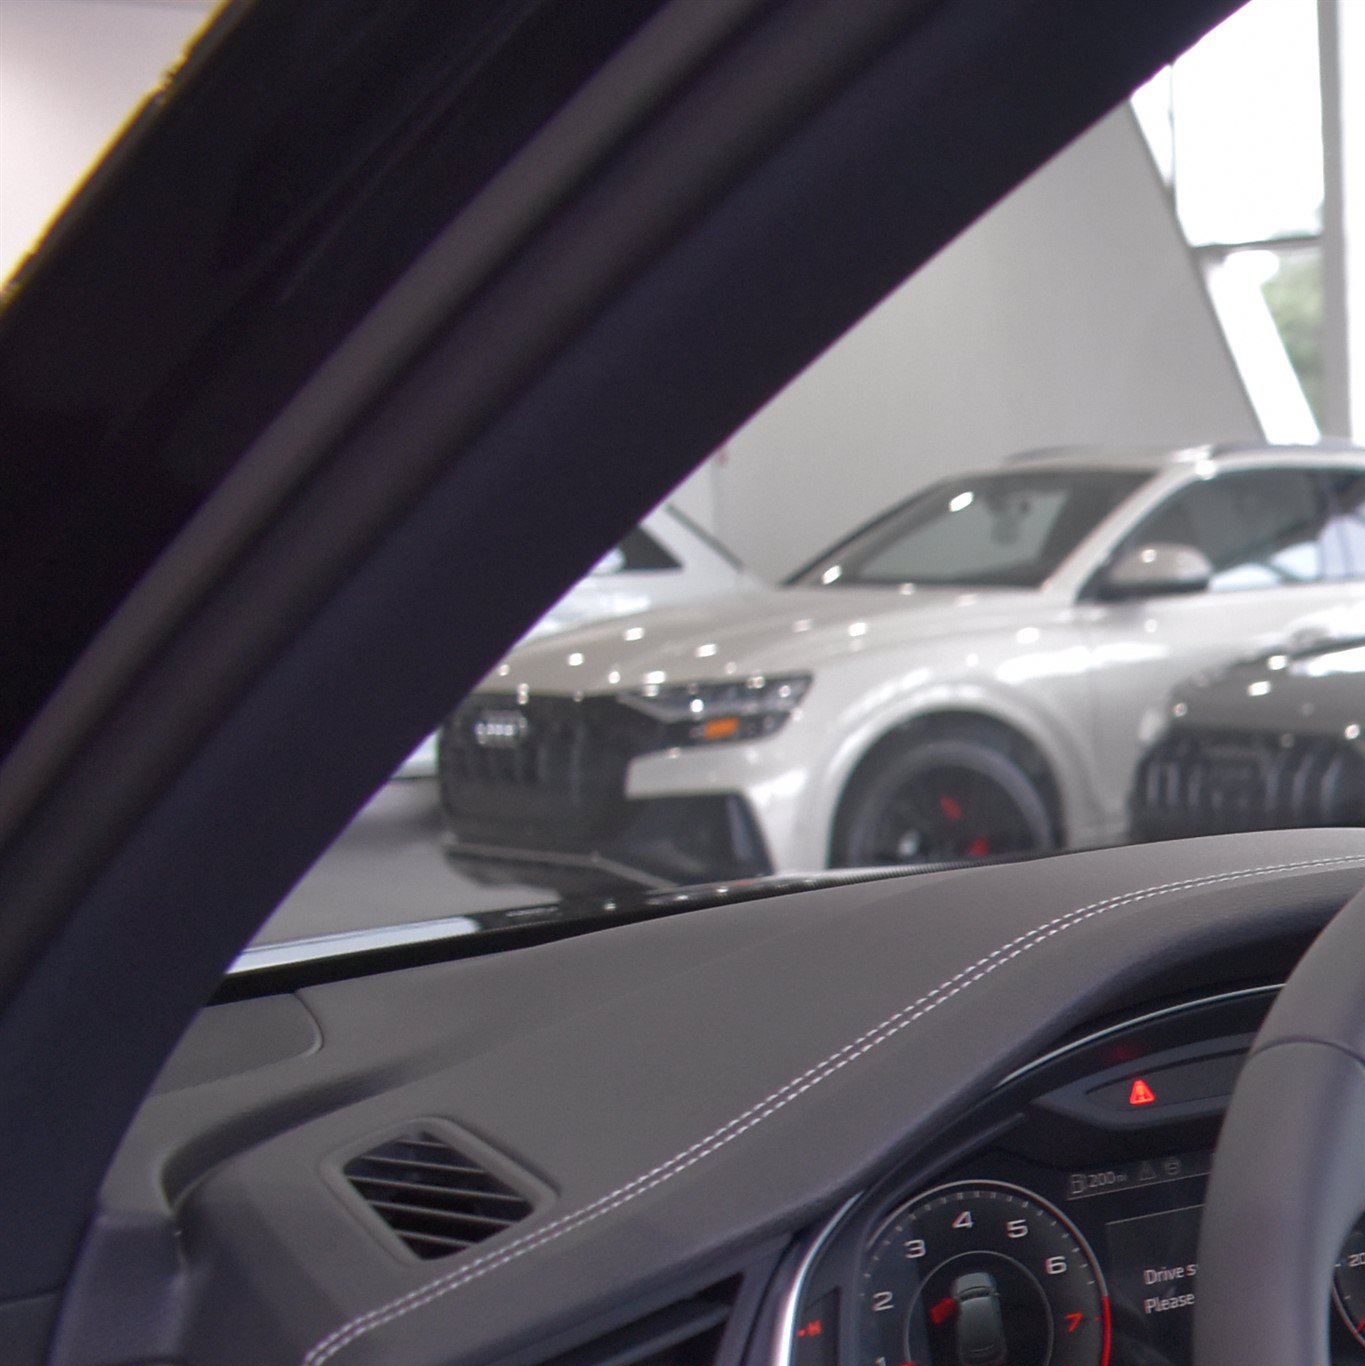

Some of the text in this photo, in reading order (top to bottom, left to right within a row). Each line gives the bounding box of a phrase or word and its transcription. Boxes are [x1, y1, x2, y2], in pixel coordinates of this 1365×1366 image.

[952, 1210, 974, 1229] 4
[1006, 1218, 1029, 1239] 5
[903, 1239, 926, 1259] 3
[1045, 1256, 1067, 1275] 6
[1143, 1265, 1185, 1285] Drive
[872, 1291, 894, 1311] 2
[1143, 1293, 1195, 1314] Please
[1065, 1312, 1083, 1333] 7
